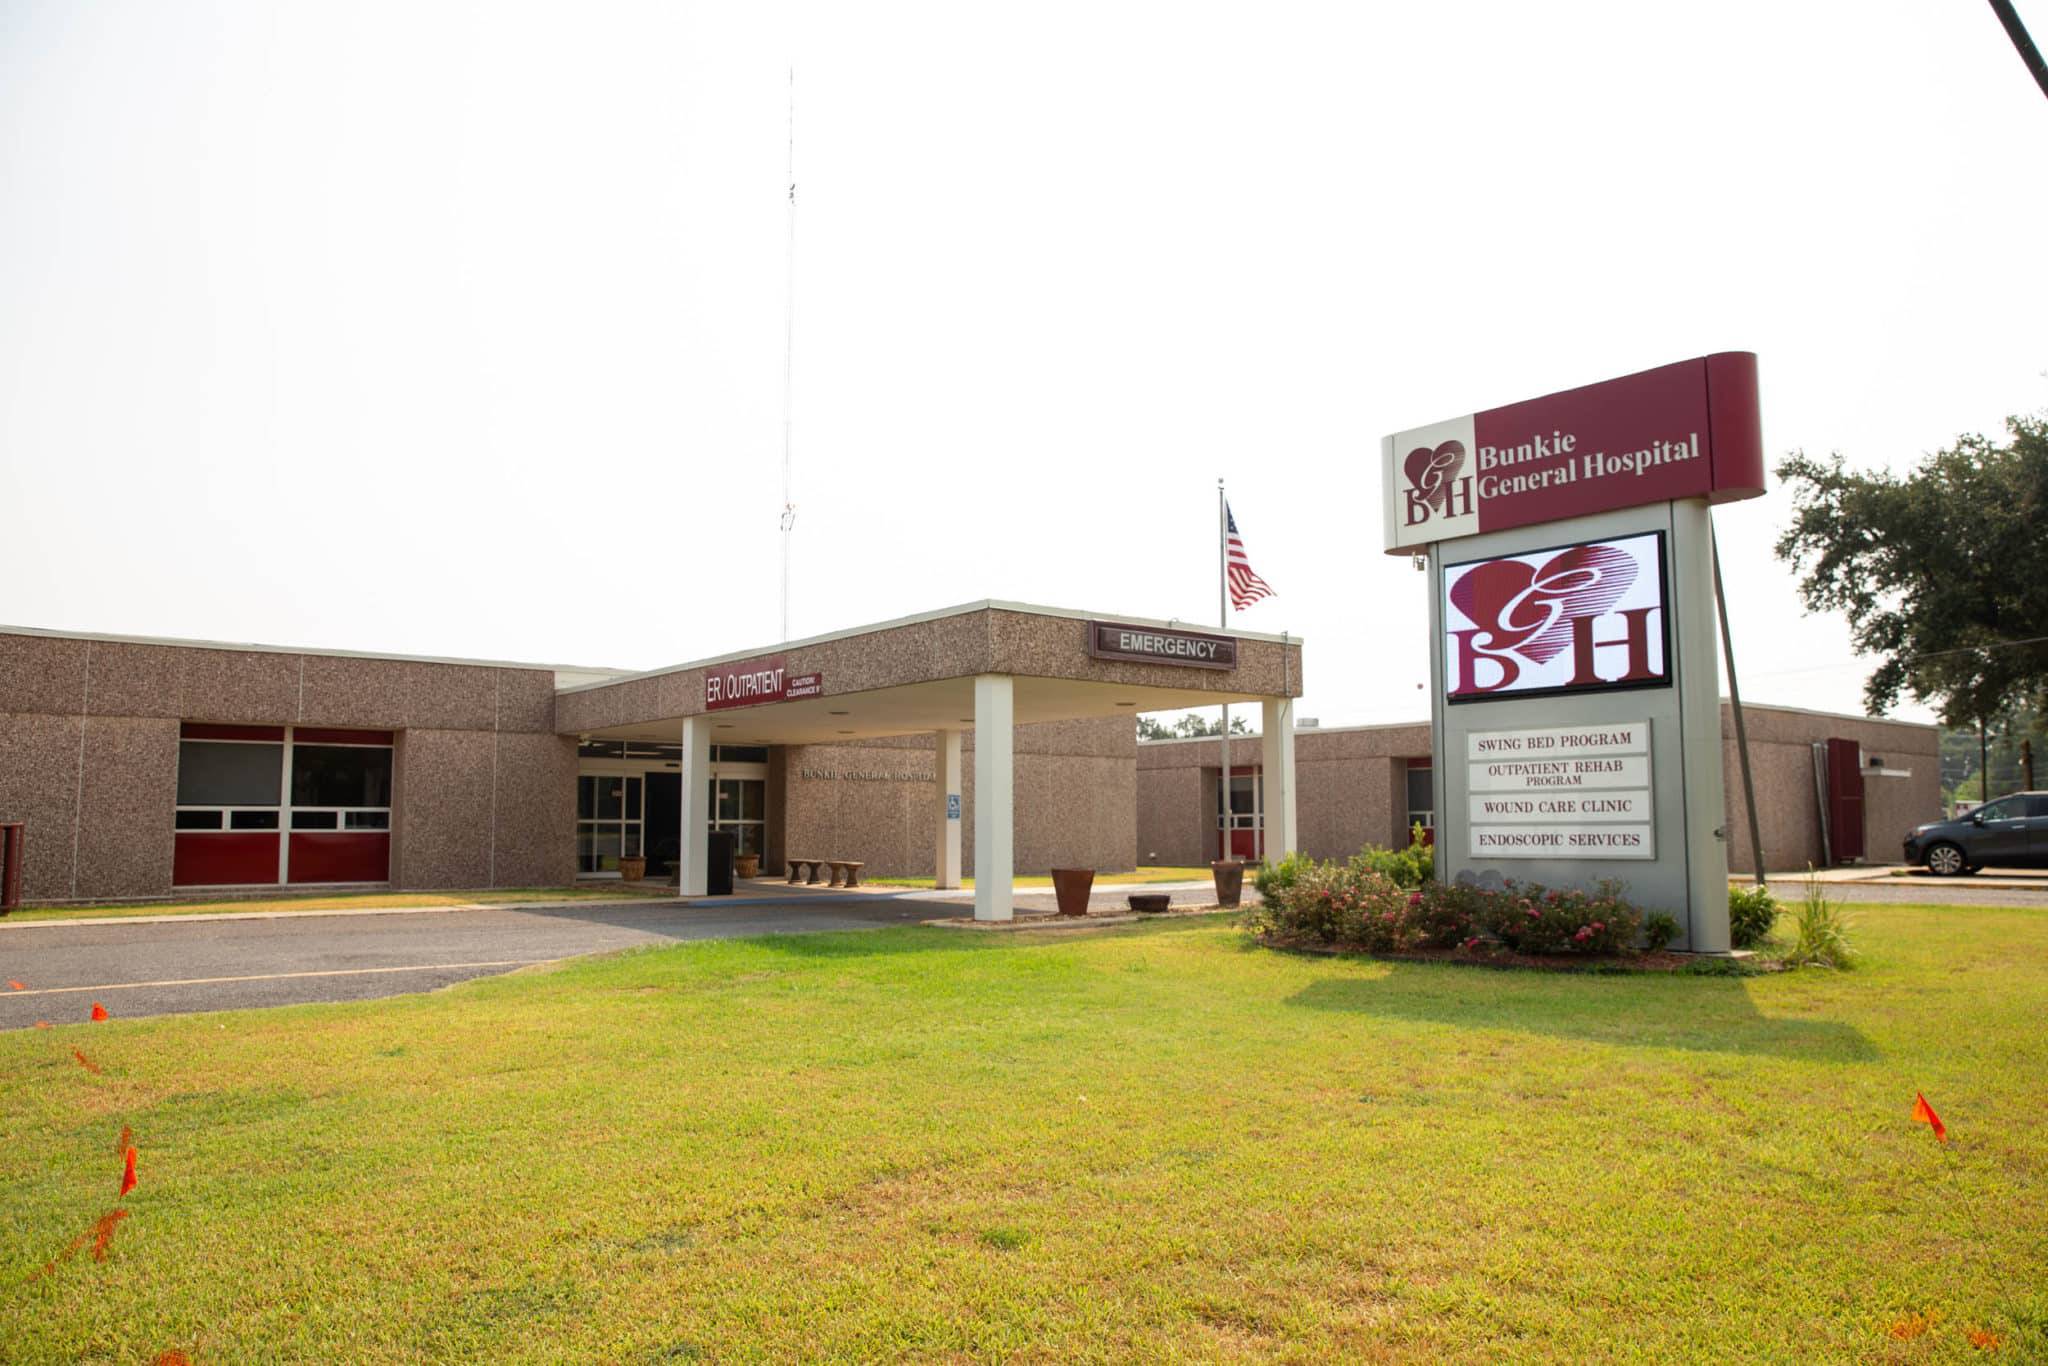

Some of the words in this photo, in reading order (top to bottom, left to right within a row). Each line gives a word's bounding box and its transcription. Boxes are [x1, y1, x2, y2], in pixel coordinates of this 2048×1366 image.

[1479, 431, 1577, 471] Bunkie
[1478, 458, 1577, 499] General
[1583, 432, 1700, 480] Hospital
[1120, 632, 1217, 658] EMERGENCY
[1478, 738, 1521, 751] SWING
[1527, 736, 1555, 749] BED
[1561, 732, 1632, 747] PROGRAM
[1488, 762, 1569, 776] OUTPATIENT
[1575, 760, 1623, 773] REHAB
[1526, 775, 1582, 786] PROGRAM
[1484, 801, 1533, 814] WOUND
[1538, 800, 1577, 813] CARE
[1581, 799, 1632, 812] CLINIC
[1479, 834, 1563, 846] ENDOSCOPIC
[1569, 834, 1641, 846] SERVICES
